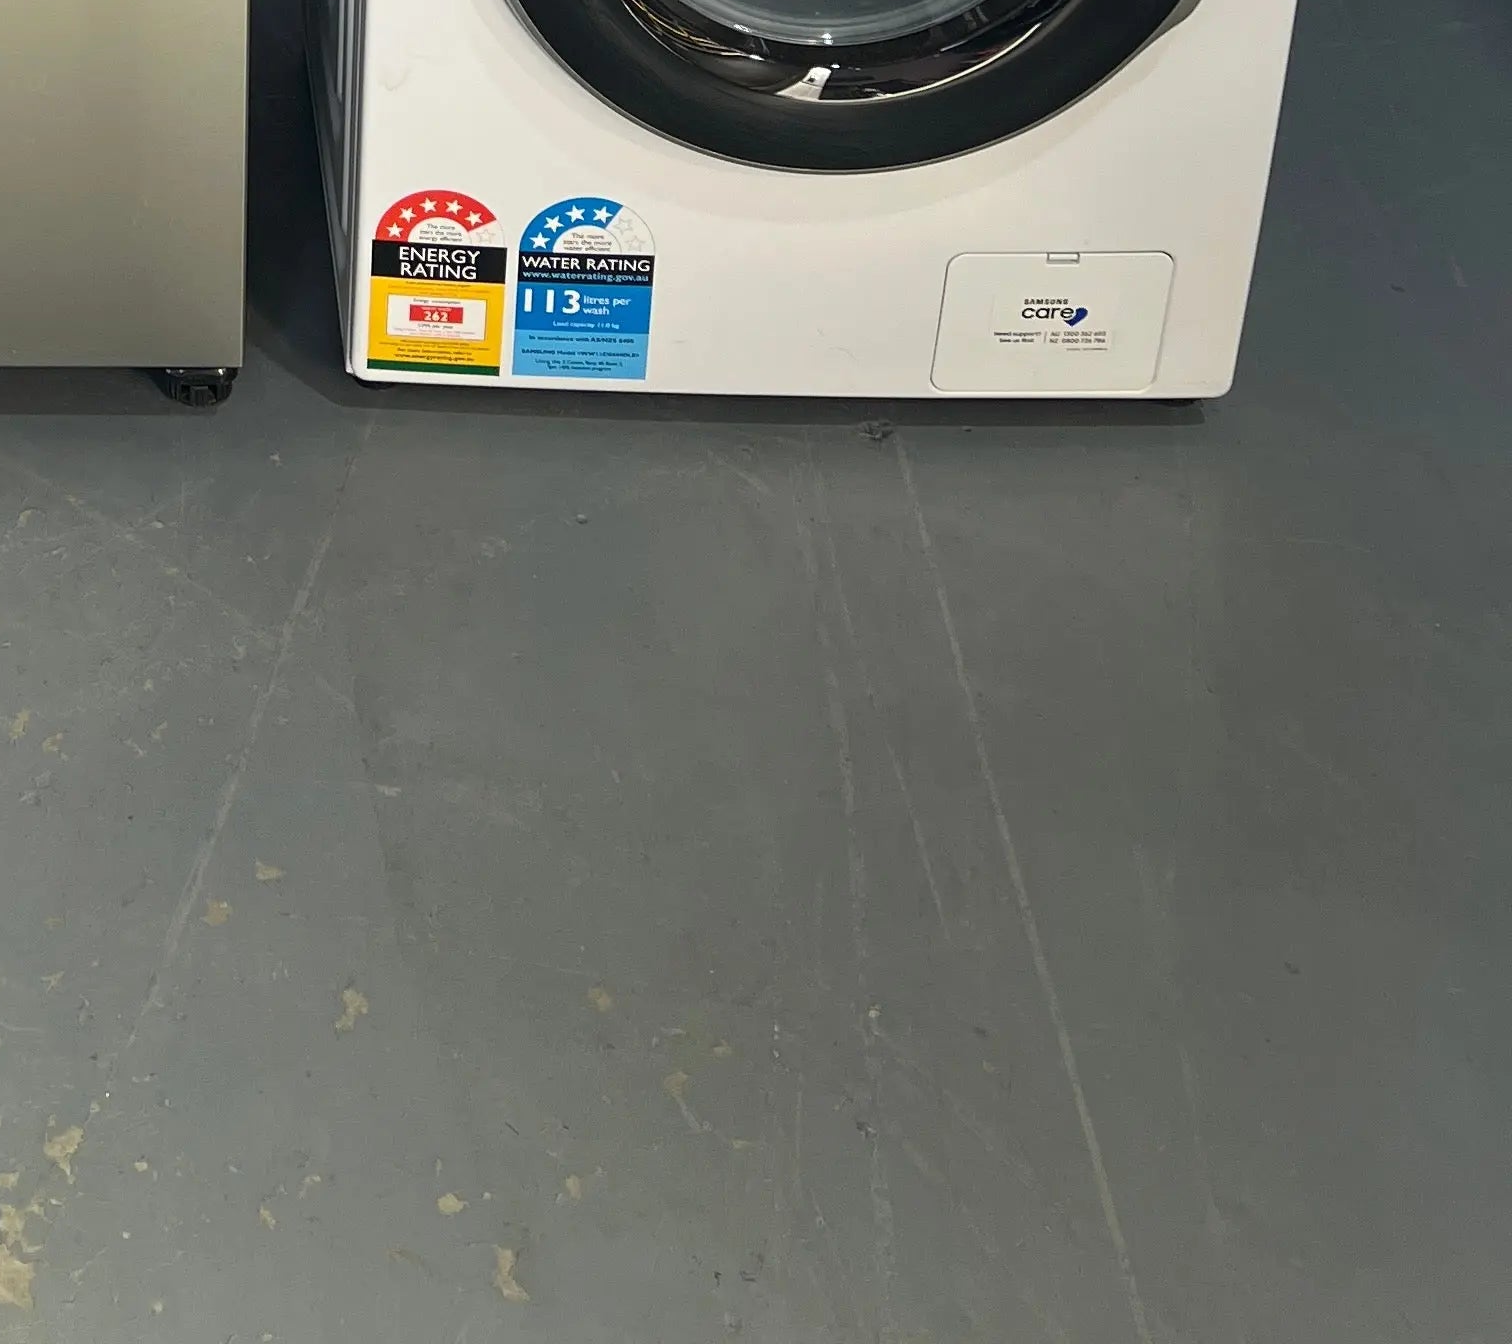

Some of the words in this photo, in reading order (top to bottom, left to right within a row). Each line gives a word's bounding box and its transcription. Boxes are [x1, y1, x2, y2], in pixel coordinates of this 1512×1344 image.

[398, 245, 481, 265] ENERGY
[521, 254, 581, 271] WATER
[586, 257, 651, 273] RATING
[399, 261, 477, 281] RATING
[521, 271, 649, 283] www.waterrating.gov.au
[523, 287, 581, 315] 113
[582, 295, 610, 305] litres
[612, 296, 632, 308] per
[582, 305, 610, 316] wash
[1021, 306, 1075, 320] care
